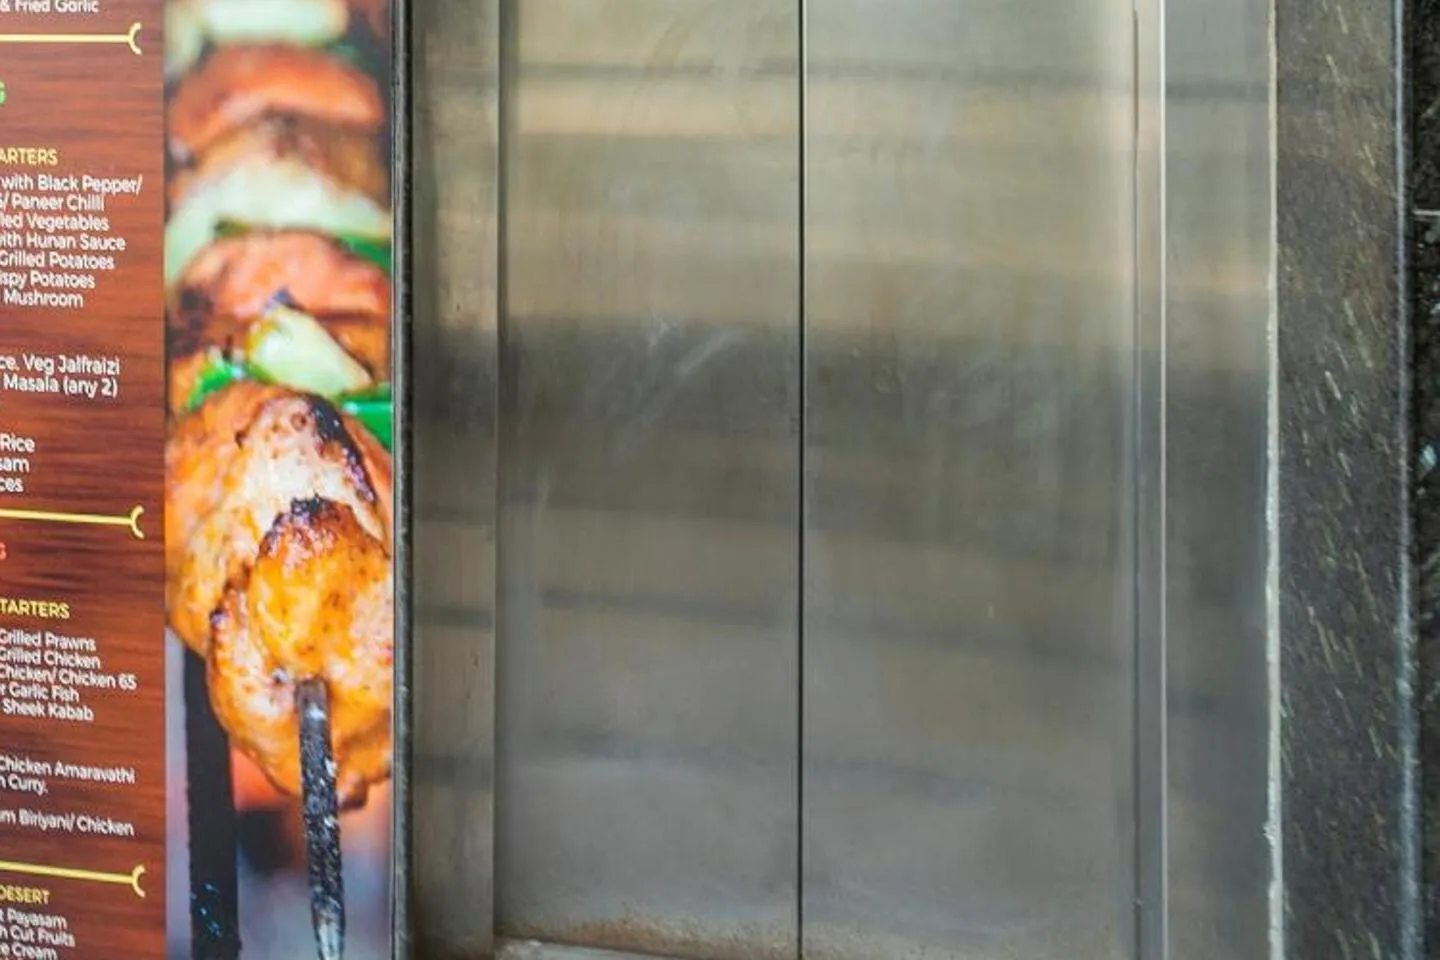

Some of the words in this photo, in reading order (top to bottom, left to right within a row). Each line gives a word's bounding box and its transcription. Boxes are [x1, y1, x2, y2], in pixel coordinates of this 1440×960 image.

[1, 173, 33, 190] with
[38, 174, 79, 192] Black
[12, 193, 63, 211] Paneer
[67, 194, 105, 212] Chilli
[26, 213, 109, 233] Vegetables
[26, 232, 76, 249] Hunan
[79, 233, 127, 252] Sauce
[49, 252, 115, 270] Potatoes
[30, 271, 95, 289] Potatoes
[4, 287, 84, 308] Mushroom
[22, 353, 54, 376] Veg
[4, 373, 59, 393] Masala
[0, 433, 35, 452] Rice
[45, 632, 97, 652] Prawns
[44, 650, 100, 669] Chicken
[60, 669, 115, 689] Chicken
[9, 681, 49, 700] Garlic
[52, 684, 79, 704] Fish
[77, 815, 134, 836] Chicken
